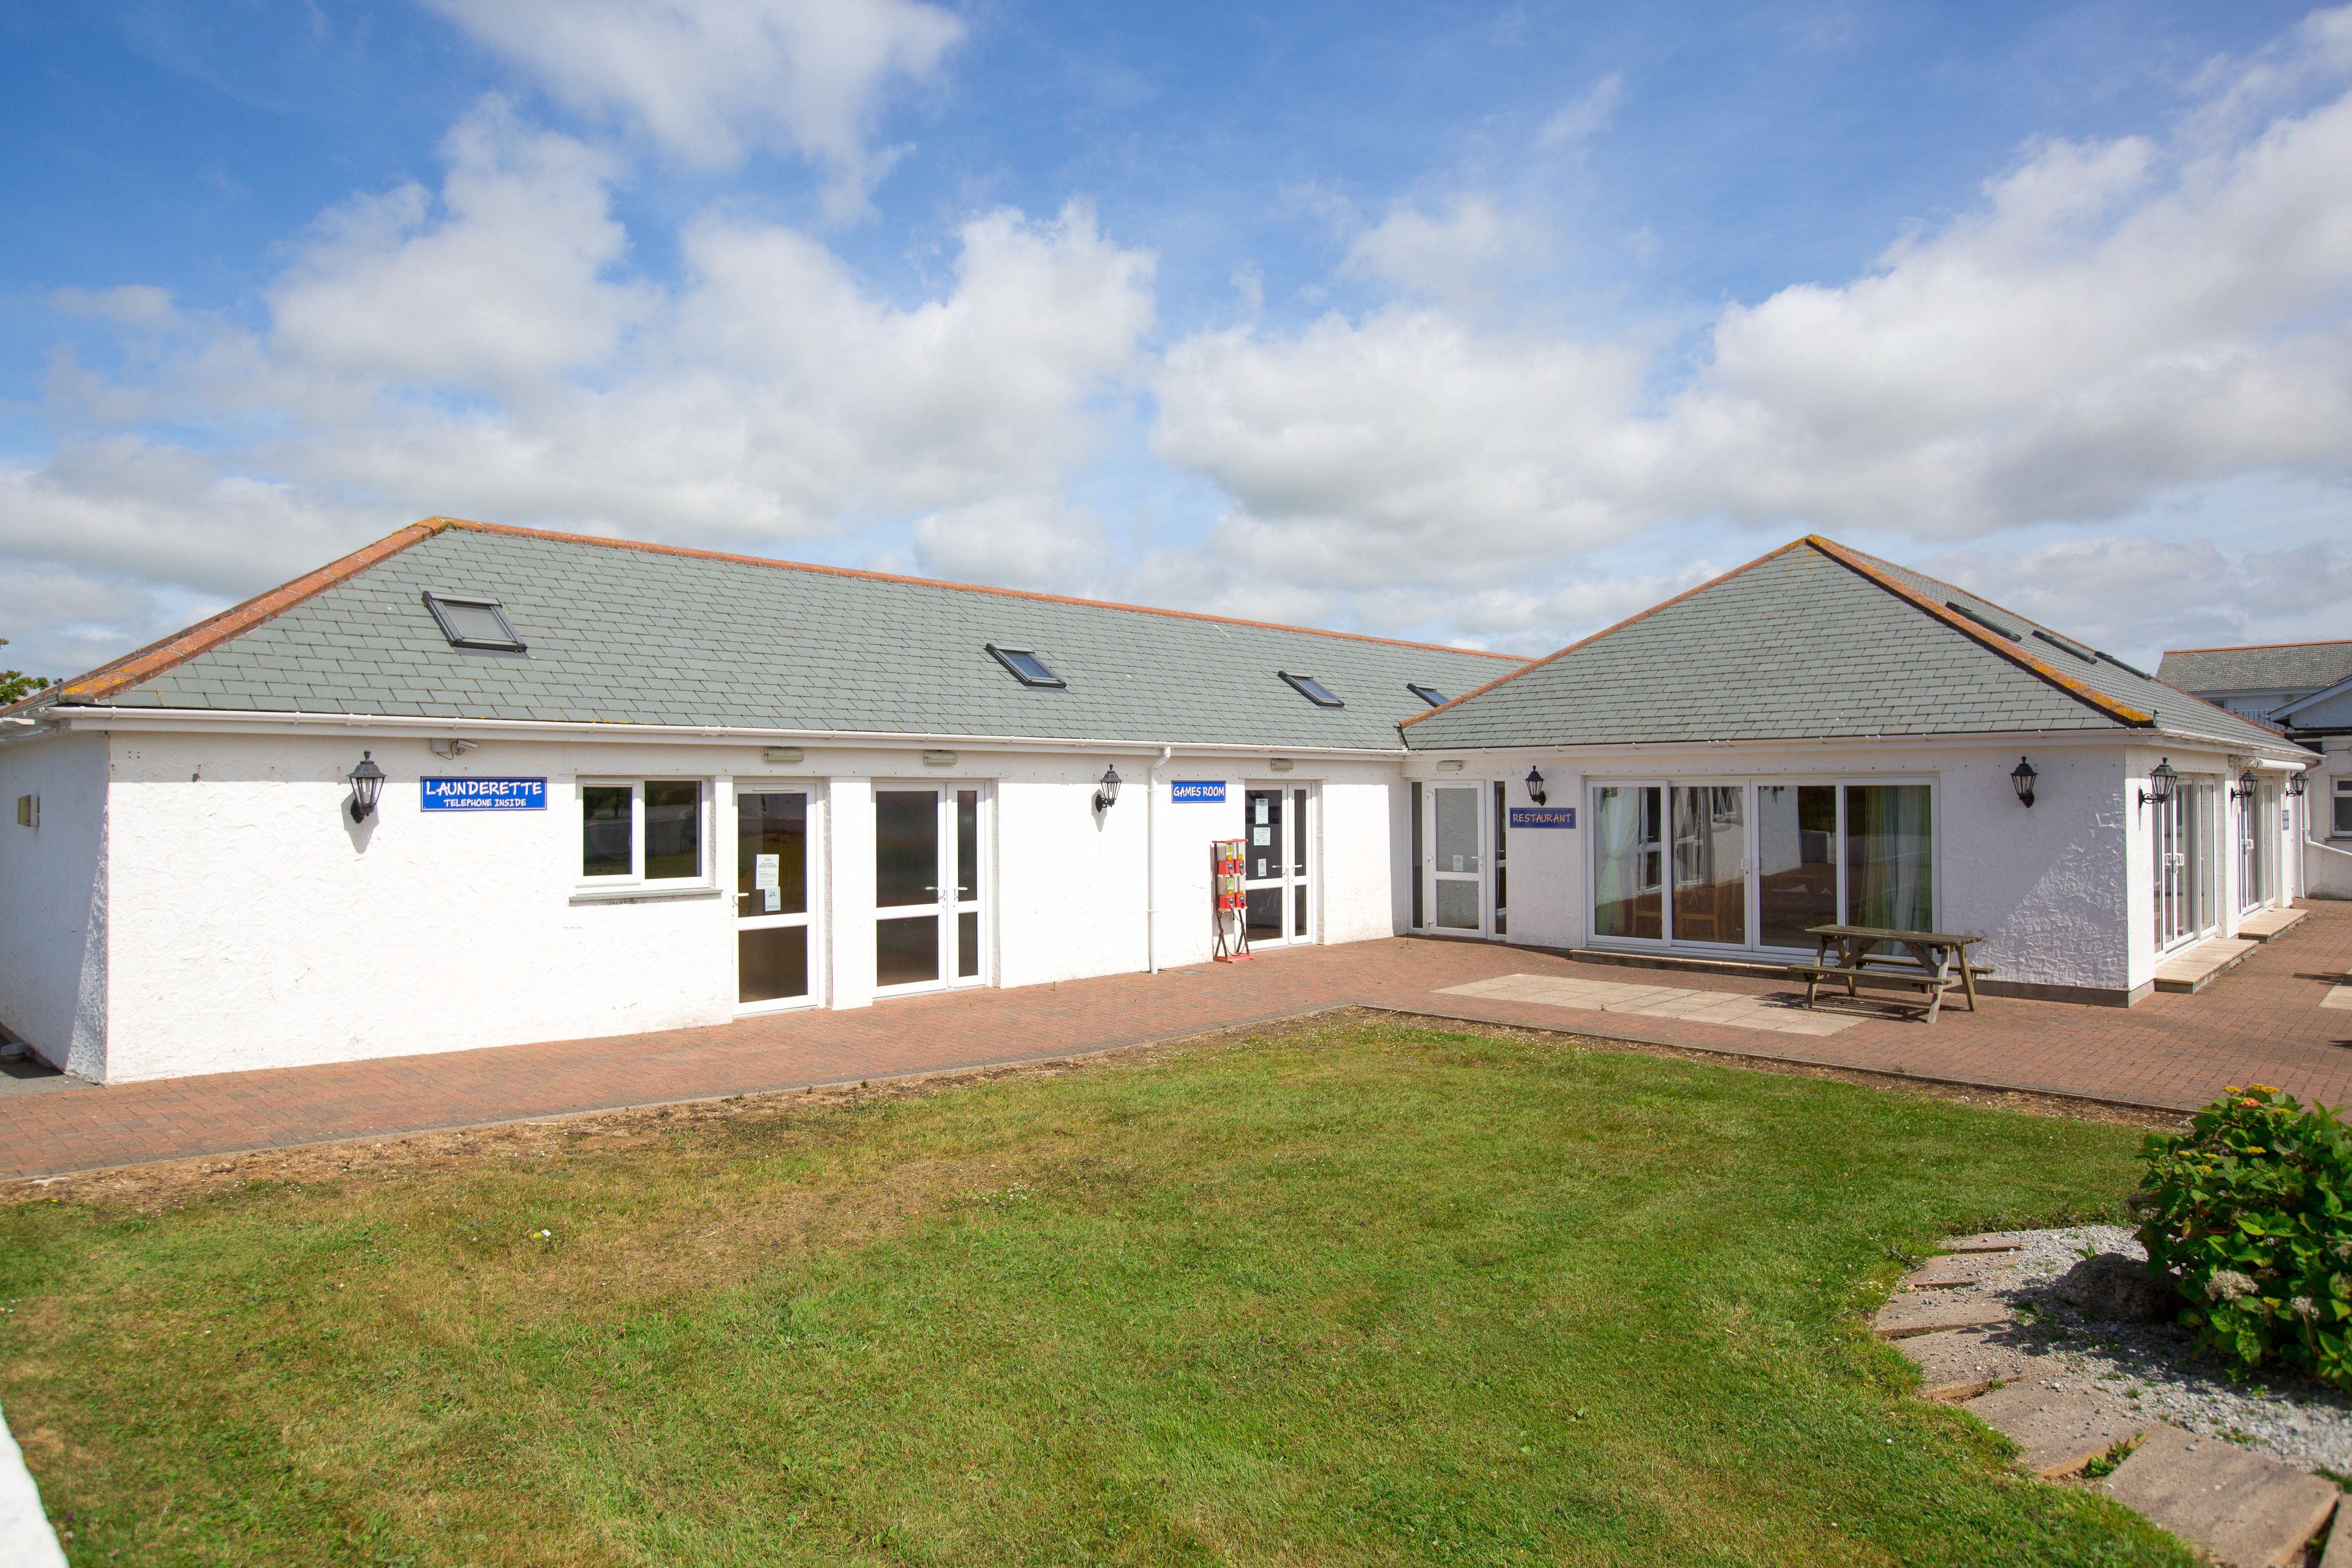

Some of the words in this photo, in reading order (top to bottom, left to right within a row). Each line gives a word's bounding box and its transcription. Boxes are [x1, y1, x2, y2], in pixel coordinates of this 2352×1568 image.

[426, 781, 543, 796] LAUNDERETTE
[1173, 786, 1202, 797] GAMES
[1202, 786, 1225, 797] ROOM
[443, 798, 492, 807] TELEPHONE
[494, 798, 527, 807] INSIDE
[1512, 813, 1572, 823] RESTAURANT
